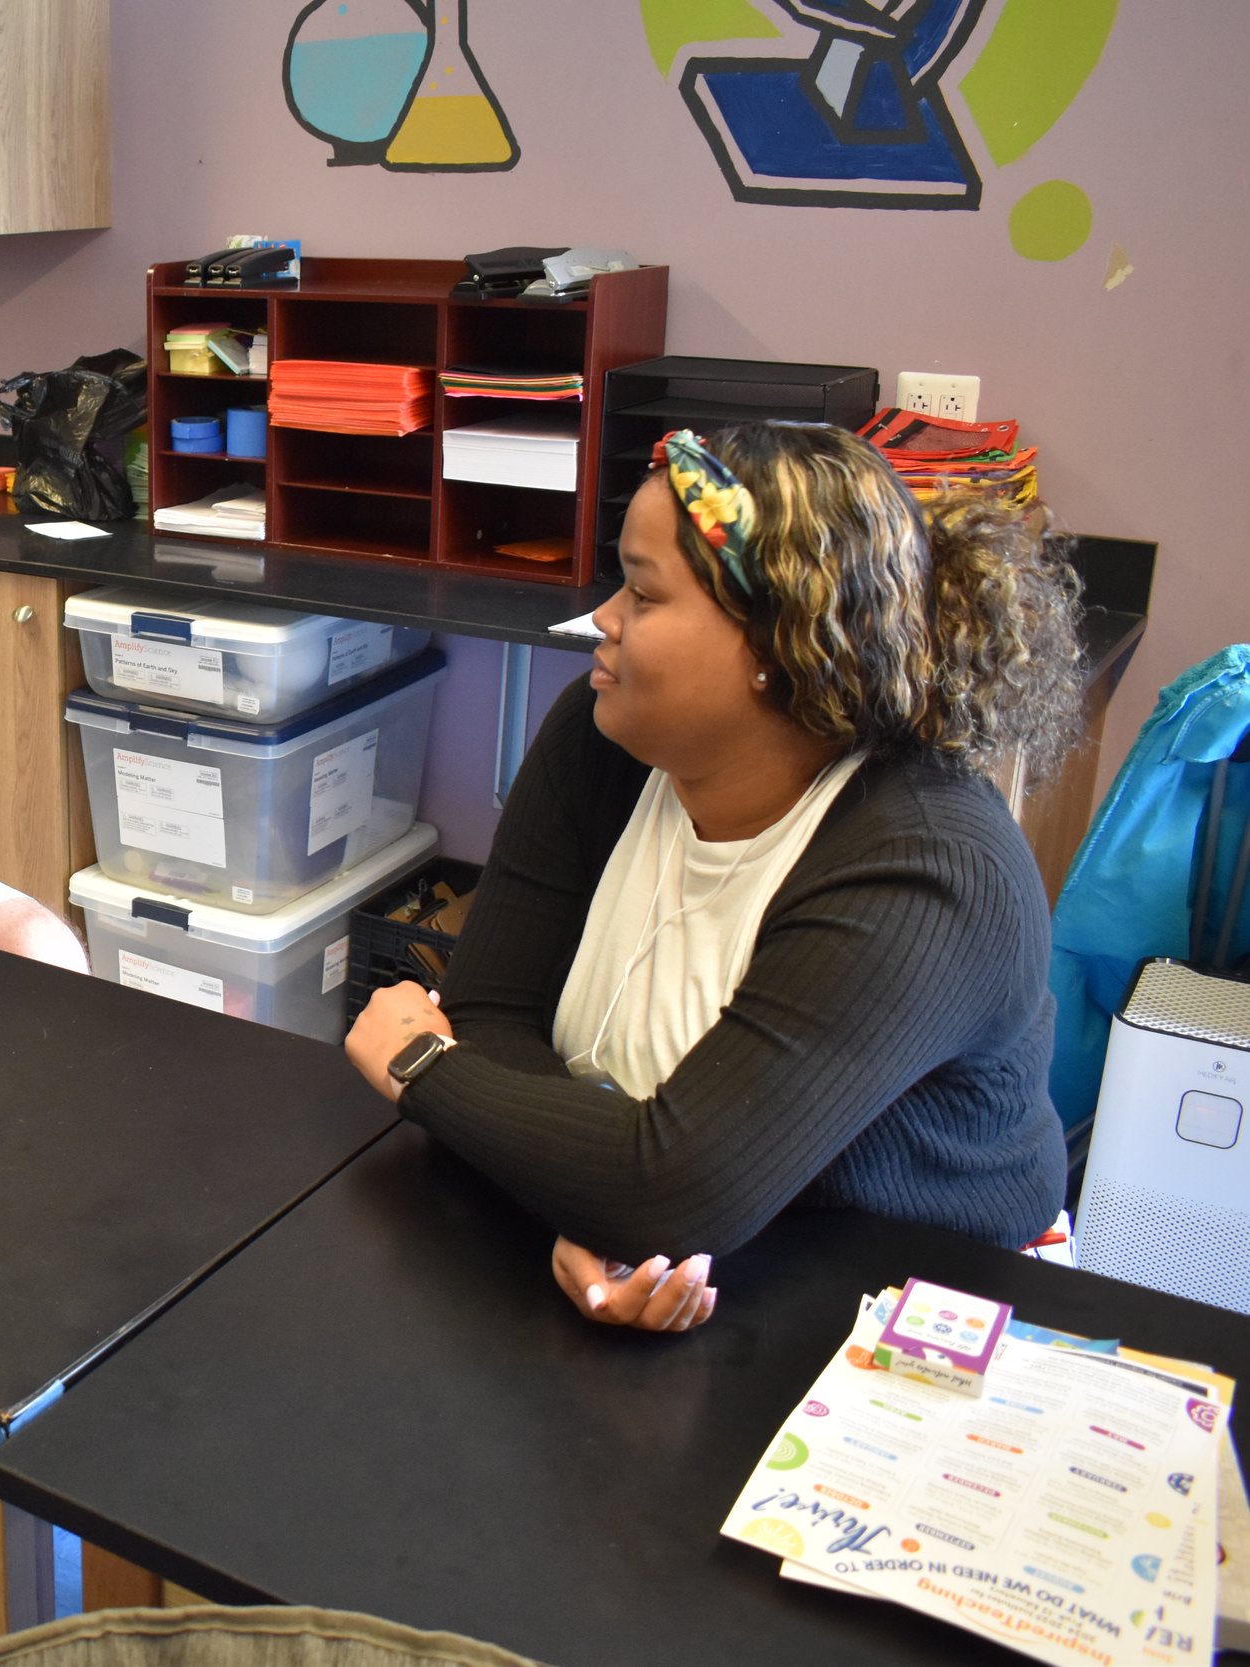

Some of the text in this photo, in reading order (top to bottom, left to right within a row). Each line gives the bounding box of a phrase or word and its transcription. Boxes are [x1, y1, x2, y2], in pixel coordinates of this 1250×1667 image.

[114, 658, 136, 668] Patterns
[143, 663, 158, 671] Earth
[158, 665, 167, 673] and
[168, 667, 179, 675] Sky
[117, 769, 157, 783] Modeling Matter
[122, 970, 143, 982] Modeling
[143, 976, 160, 986] Matter
[834, 1559, 1121, 1639] WHAT DO WE NEED IN ORDER TO
